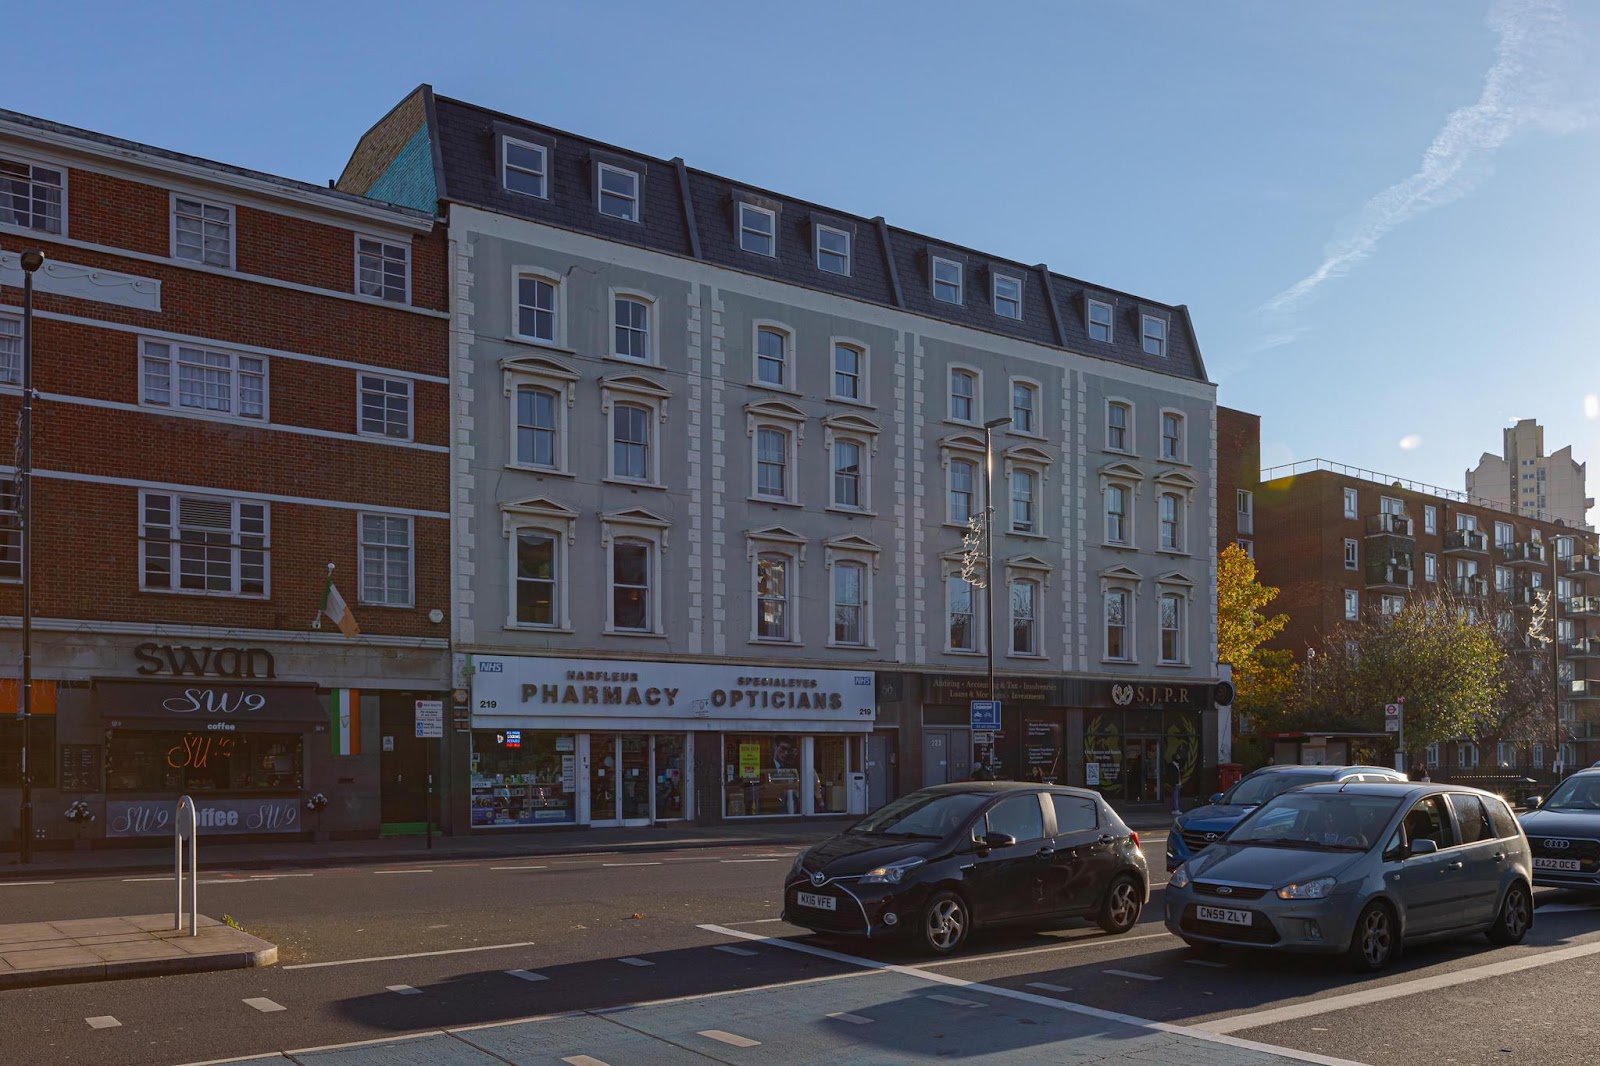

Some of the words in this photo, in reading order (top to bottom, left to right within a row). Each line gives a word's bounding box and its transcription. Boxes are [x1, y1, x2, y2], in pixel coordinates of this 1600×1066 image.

[480, 662, 502, 672] NHS
[567, 670, 638, 682] HARFLEUR
[856, 677, 871, 686] NHS
[162, 688, 266, 713] SW9
[521, 684, 679, 706] PHARMACY
[711, 689, 842, 710] OPTICIANS
[480, 700, 497, 708] 219
[207, 722, 236, 731] coffee
[1200, 907, 1225, 920] CN59
[1227, 910, 1248, 923] ZLY
